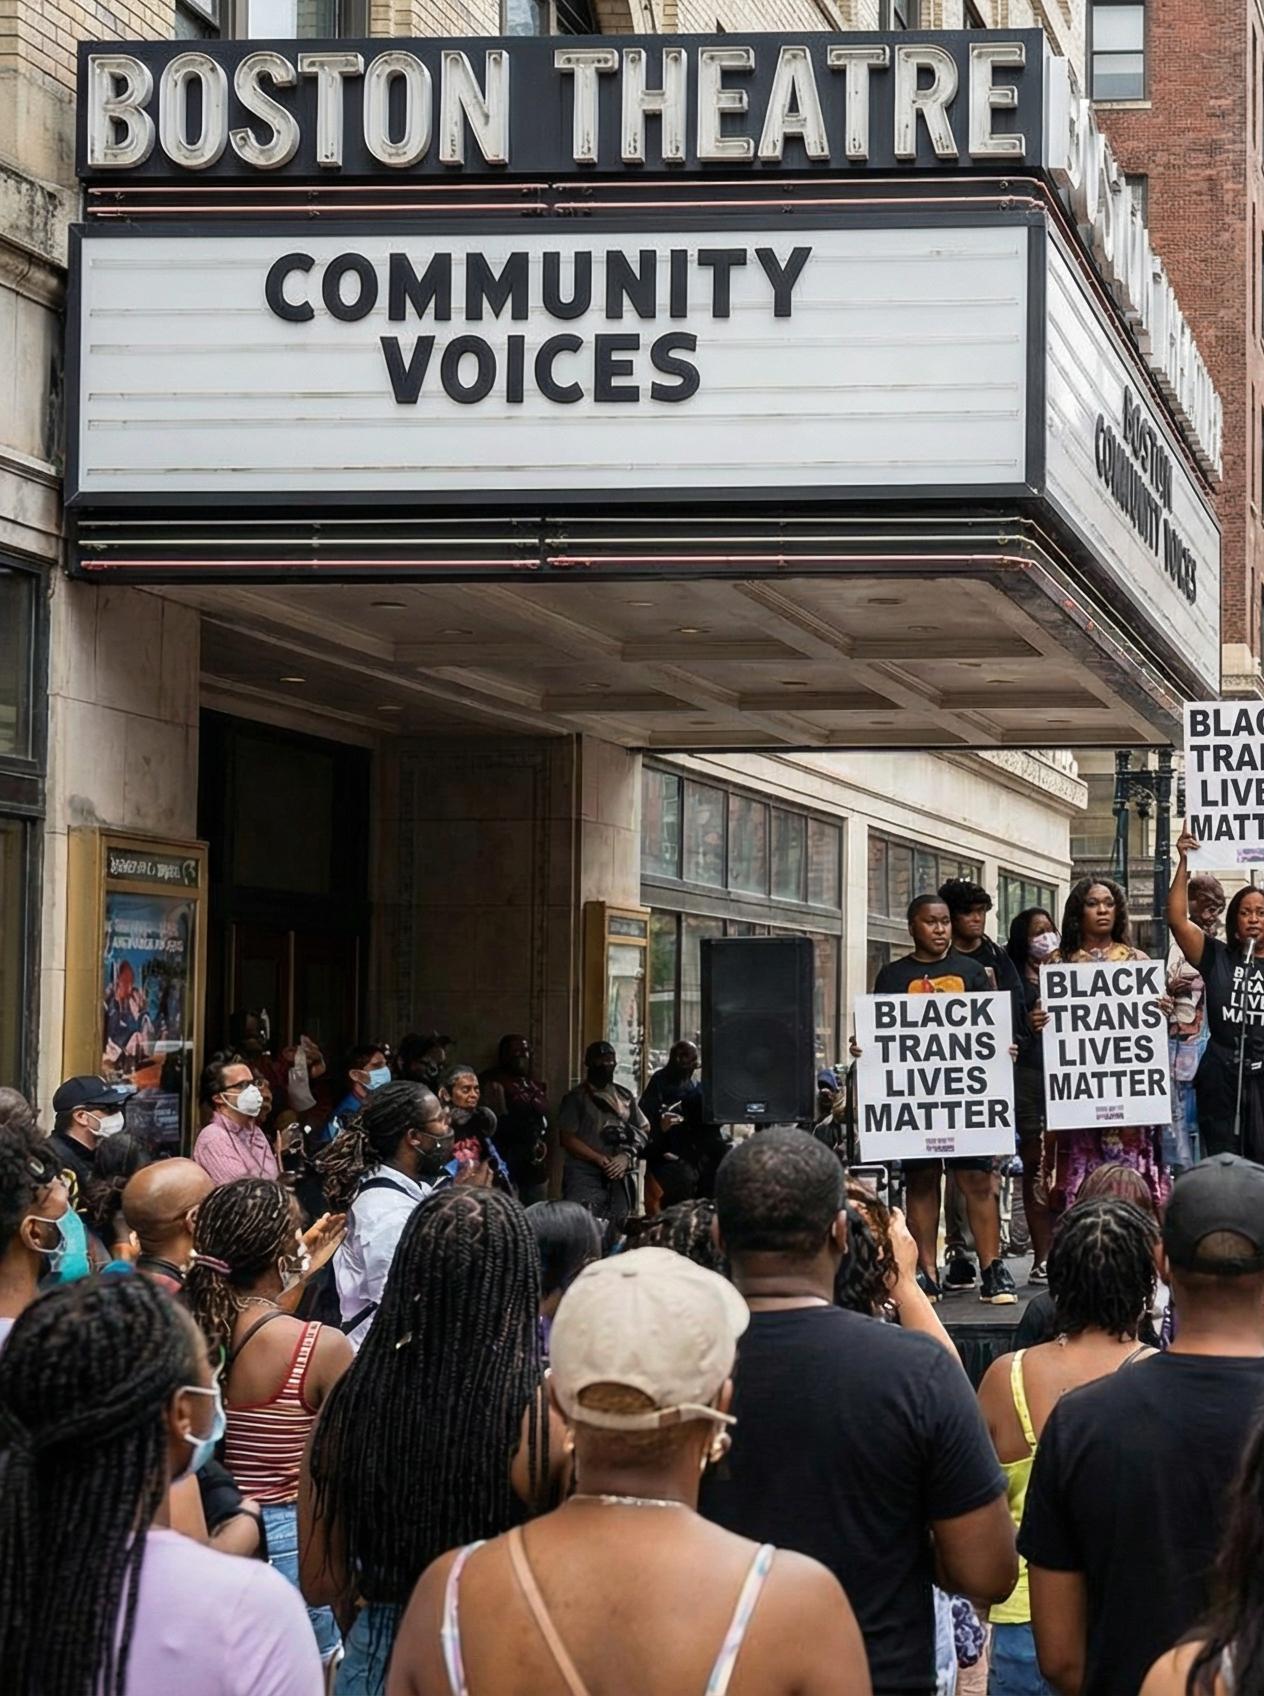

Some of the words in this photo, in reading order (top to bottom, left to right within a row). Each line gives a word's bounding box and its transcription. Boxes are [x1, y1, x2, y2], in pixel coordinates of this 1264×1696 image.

[87, 50, 510, 170] BOSTON
[554, 41, 1026, 165] THEATRE
[265, 246, 812, 322] COMMUNITY
[380, 331, 701, 405] VOICES
[1046, 967, 1159, 999] BLACK
[874, 998, 995, 1030] BLACK
[1048, 1001, 1161, 1033] TRANS
[875, 1032, 995, 1063] TRANS
[1059, 1035, 1154, 1067] LIVES
[886, 1066, 988, 1098] LIVES
[1049, 1069, 1166, 1101] MATTER
[864, 1099, 1011, 1132] MATTER
